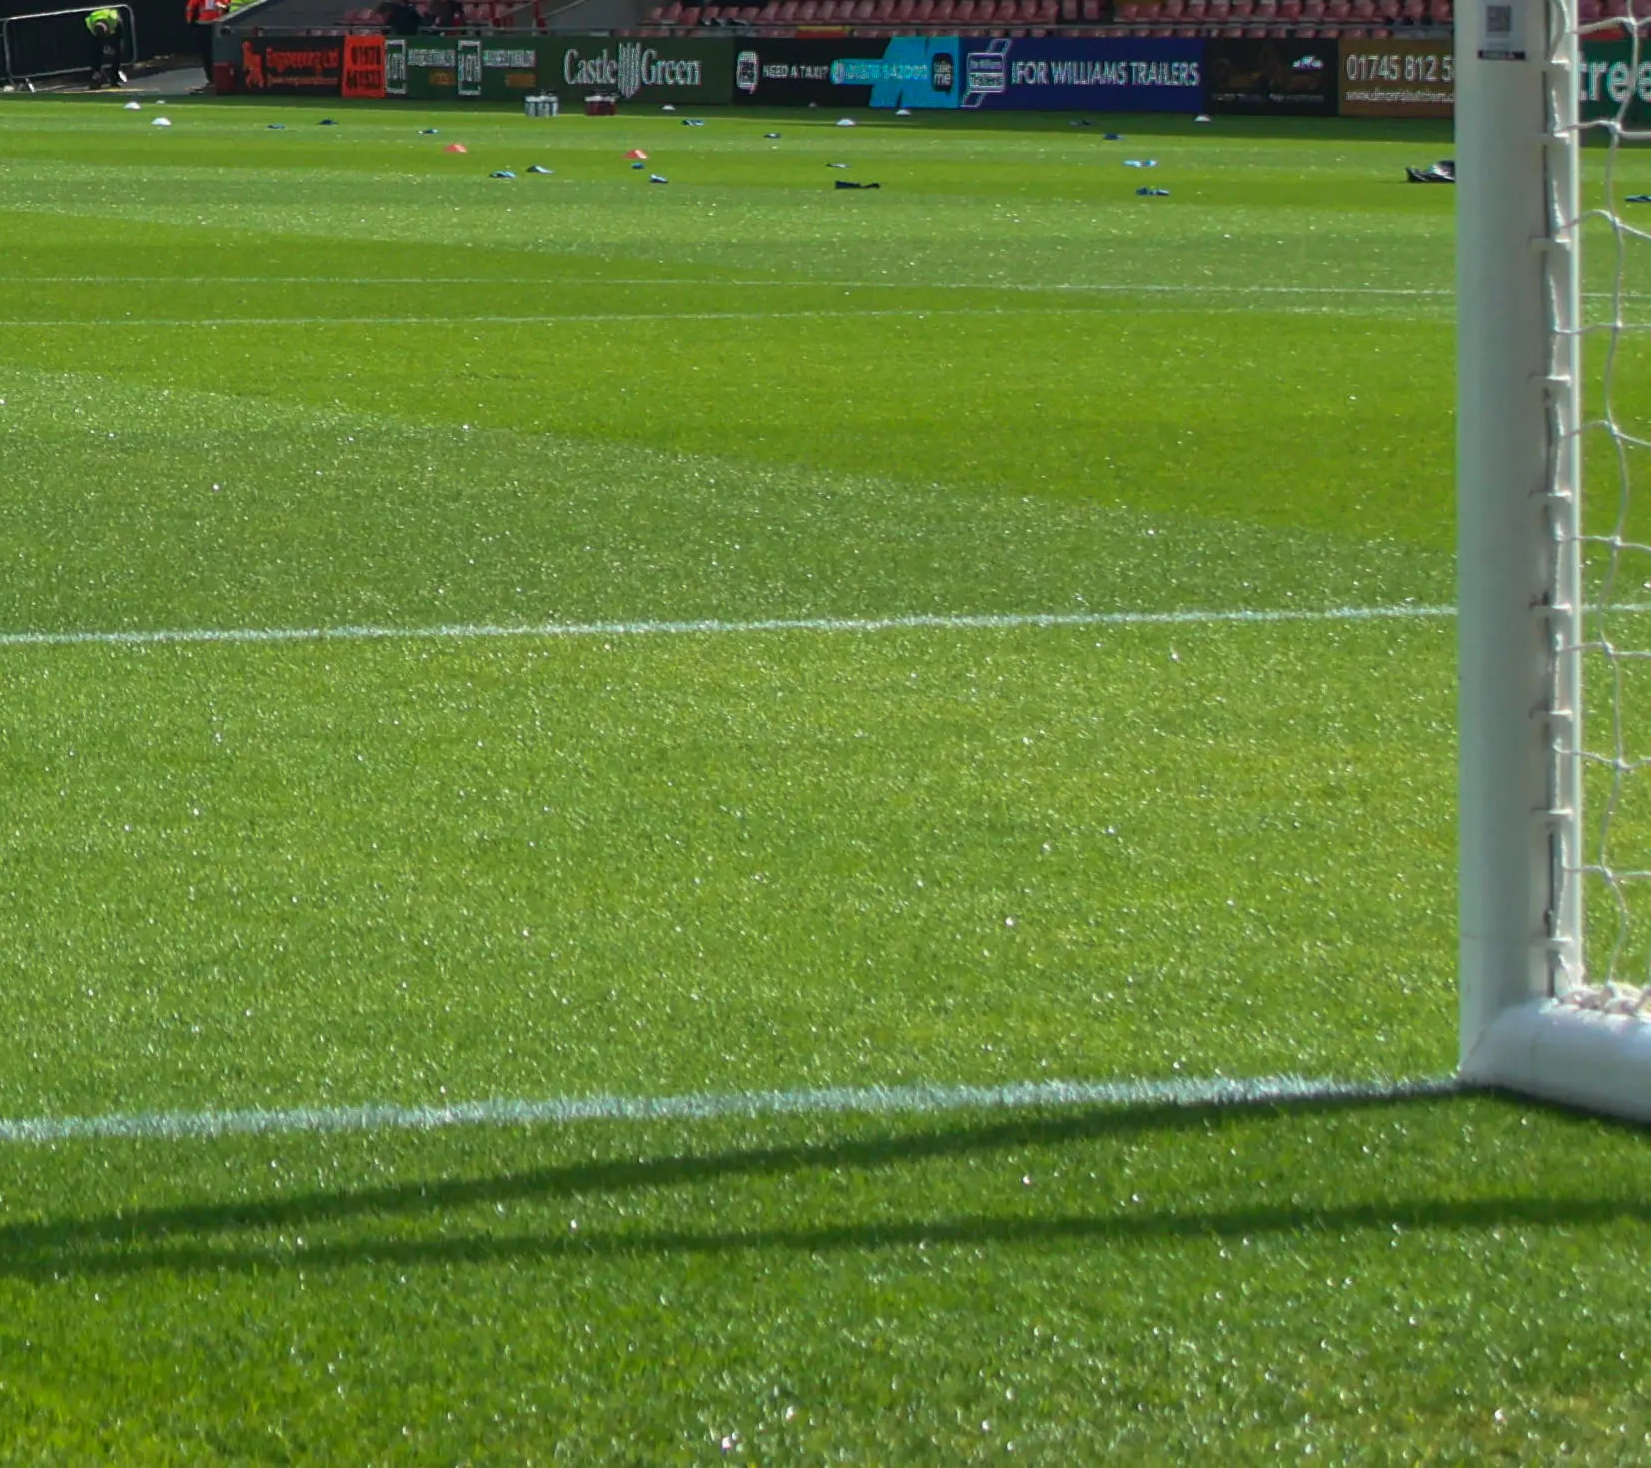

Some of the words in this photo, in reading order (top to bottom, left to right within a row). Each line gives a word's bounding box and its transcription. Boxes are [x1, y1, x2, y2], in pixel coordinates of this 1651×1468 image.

[563, 48, 617, 85] Castle
[641, 48, 703, 85] Green
[762, 65, 788, 79] NEED
[790, 65, 798, 79] A
[933, 72, 952, 86] me
[1011, 61, 1049, 85] IFOR
[1050, 62, 1127, 85] WILLIAMS
[1130, 62, 1200, 86] TRAILERS
[1346, 54, 1398, 81] 01745
[1404, 54, 1439, 81] 812
